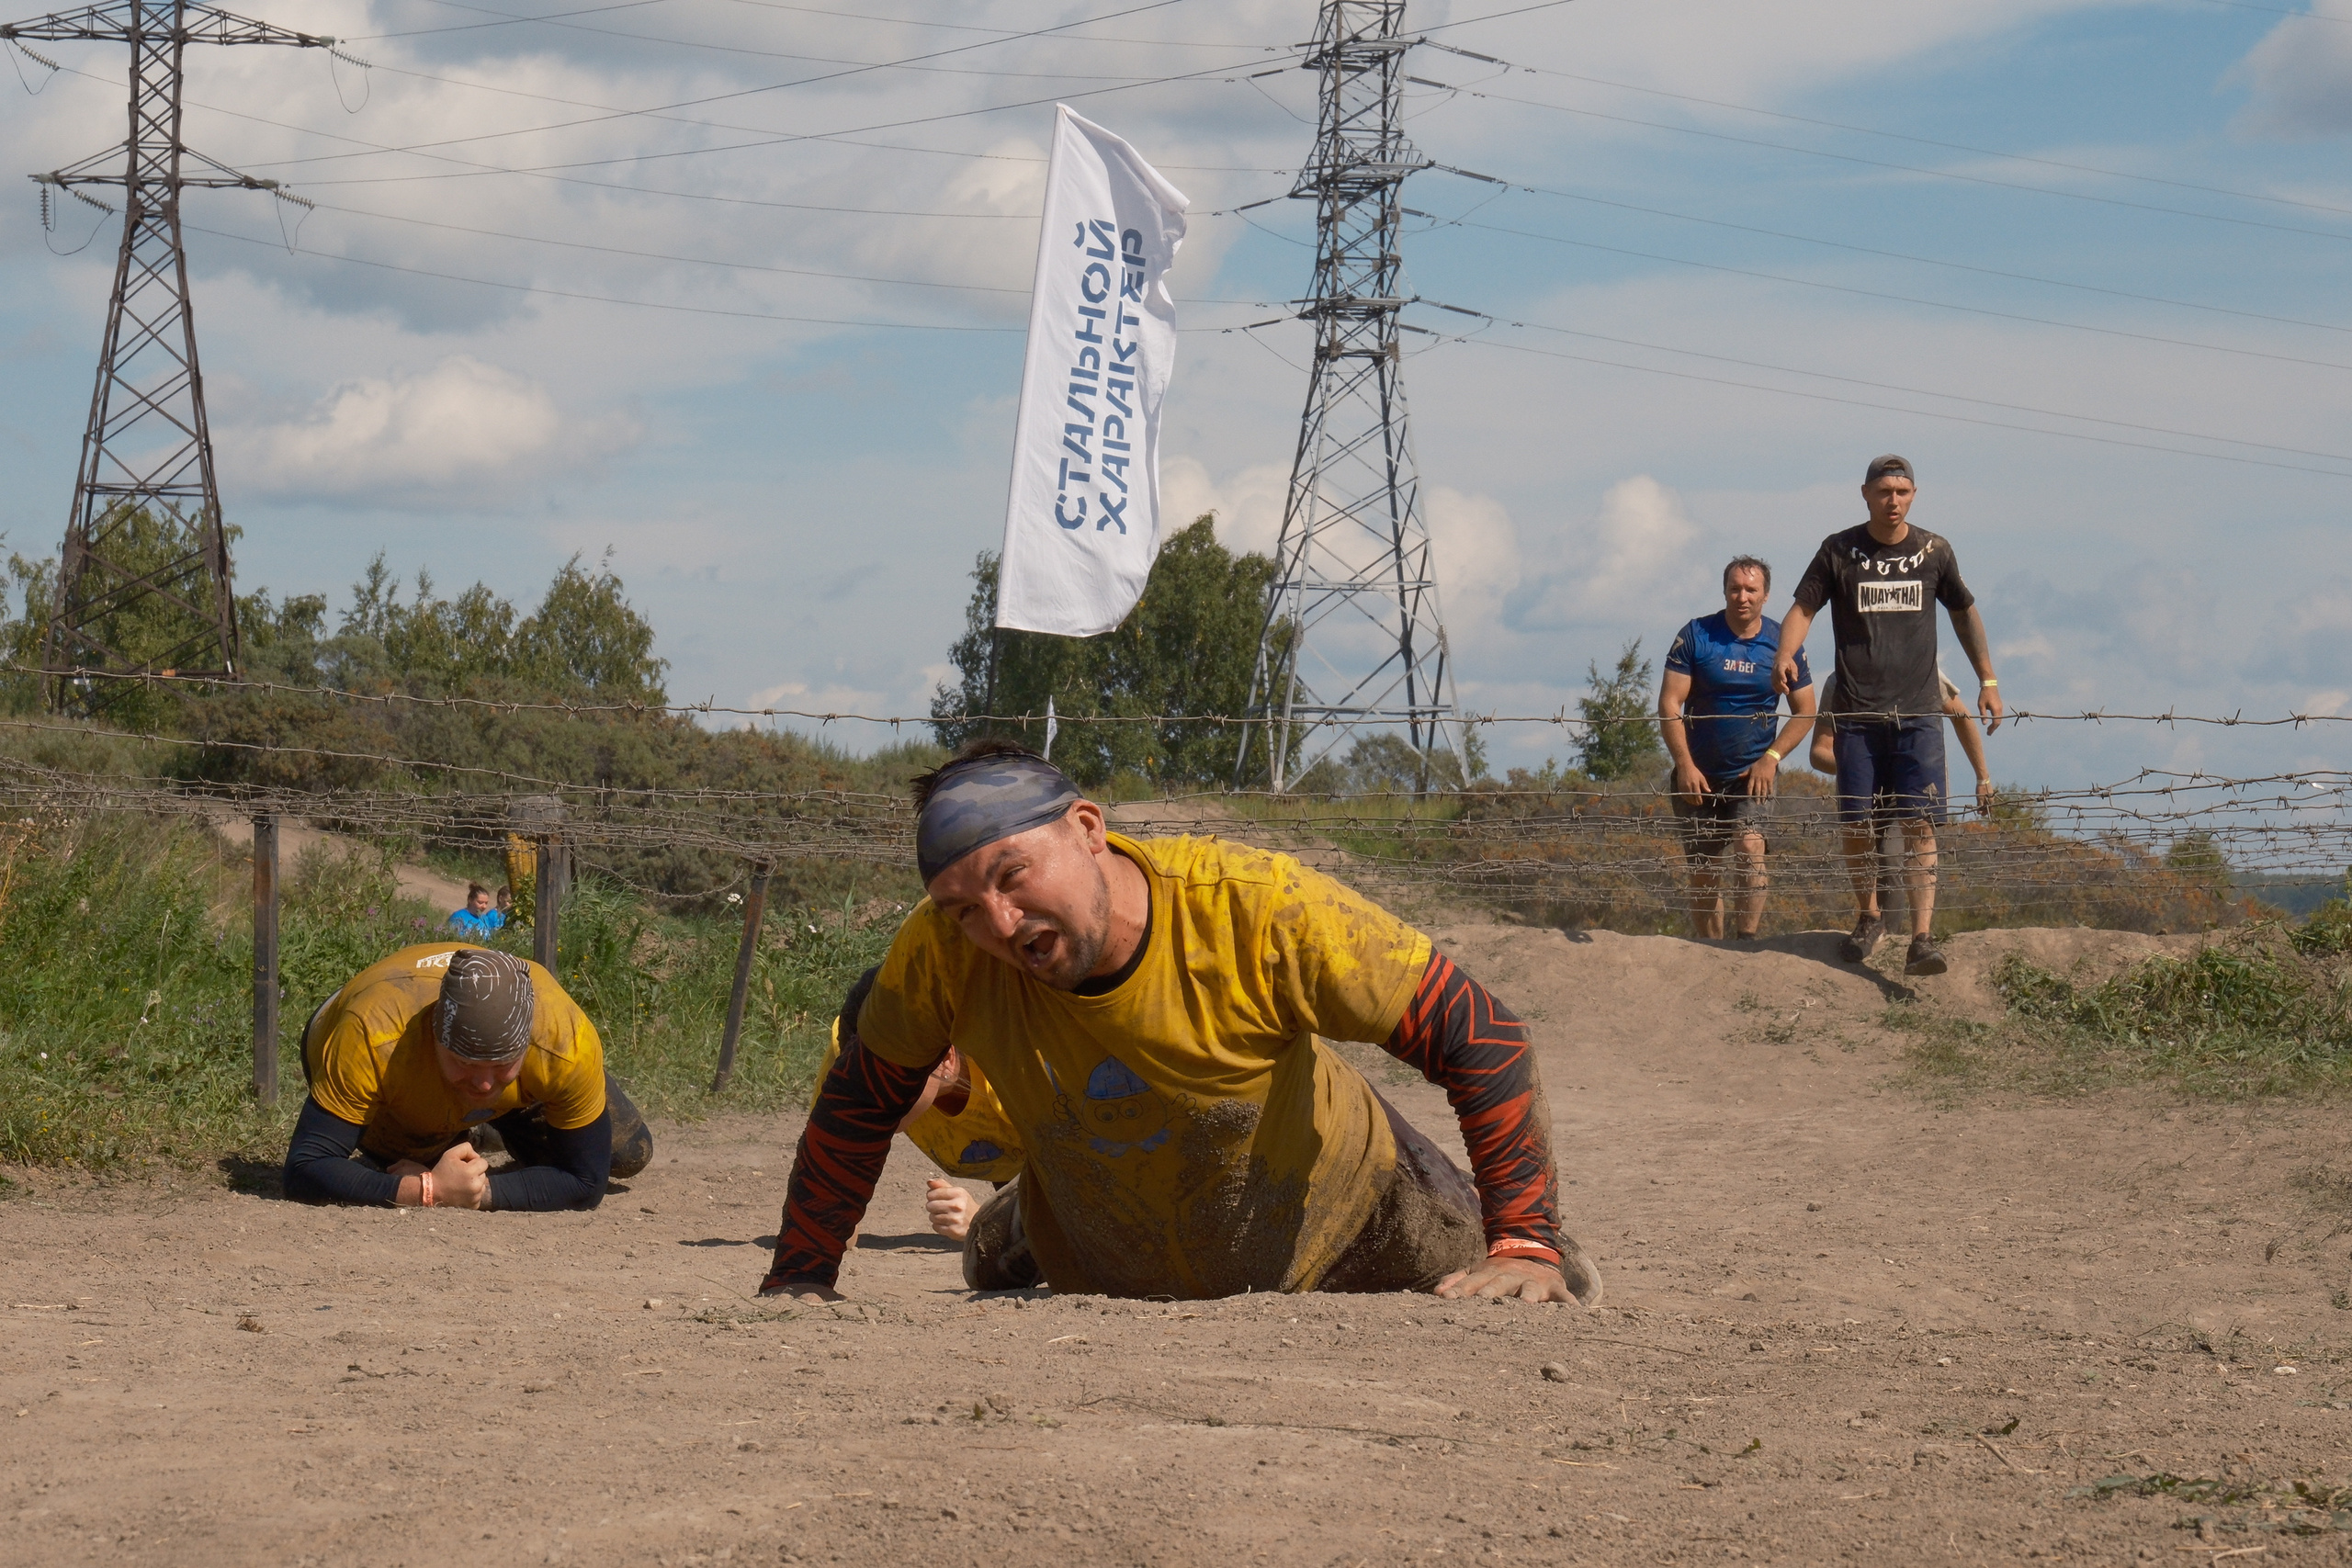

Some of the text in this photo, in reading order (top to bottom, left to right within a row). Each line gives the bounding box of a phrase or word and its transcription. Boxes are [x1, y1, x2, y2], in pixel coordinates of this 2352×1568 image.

[1055, 219, 1115, 530] СТАЛЬНОЙ
[1095, 228, 1146, 535] ХАРАКТЕР
[1860, 584, 1919, 608] MUAY THAI
[442, 1013, 454, 1047] SINNER
